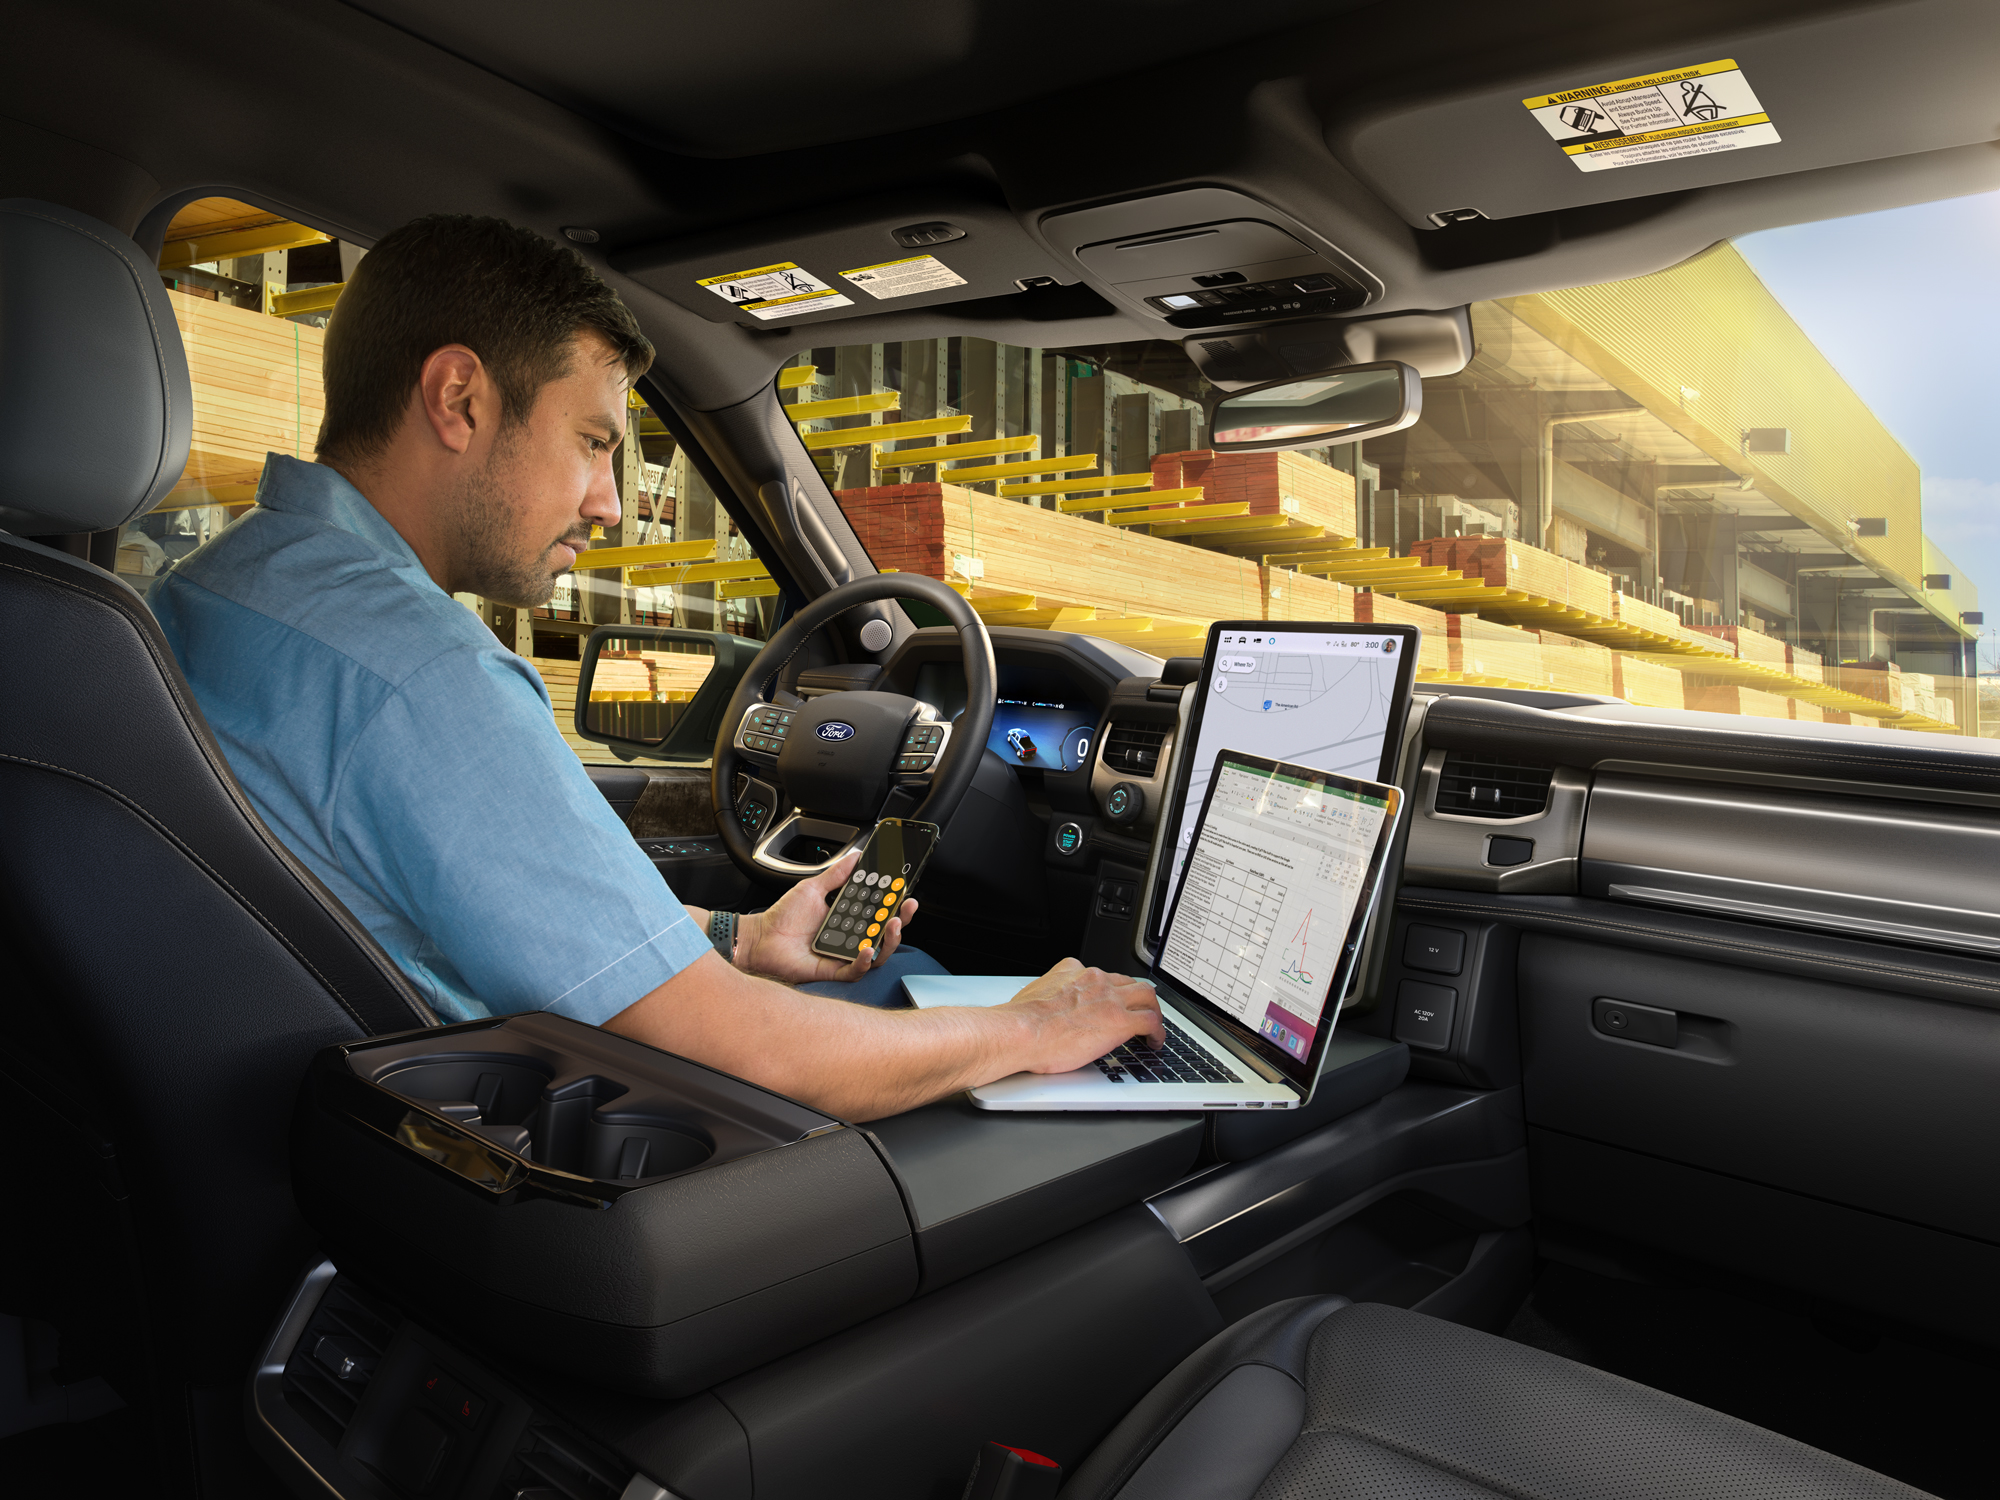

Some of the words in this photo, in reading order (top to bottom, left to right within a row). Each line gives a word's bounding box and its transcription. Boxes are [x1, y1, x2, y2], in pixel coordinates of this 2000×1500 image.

[1556, 85, 1615, 103] WARNING:
[1615, 82, 1644, 91] HIGHER
[1643, 74, 1683, 86] ROLLOVER
[1683, 70, 1701, 78] RISK
[1615, 97, 1633, 105] Abrupt
[1618, 102, 1645, 111] Excessive
[1651, 111, 1671, 119] Manual
[1648, 117, 1679, 126] Information.
[1592, 135, 1650, 149] AVERTISSEMENT:
[1365, 641, 1379, 649] 3:00
[821, 724, 847, 738] Ford
[1077, 738, 1089, 757] 0
[901, 863, 911, 874] 0
[1422, 1010, 1434, 1018] 120V
